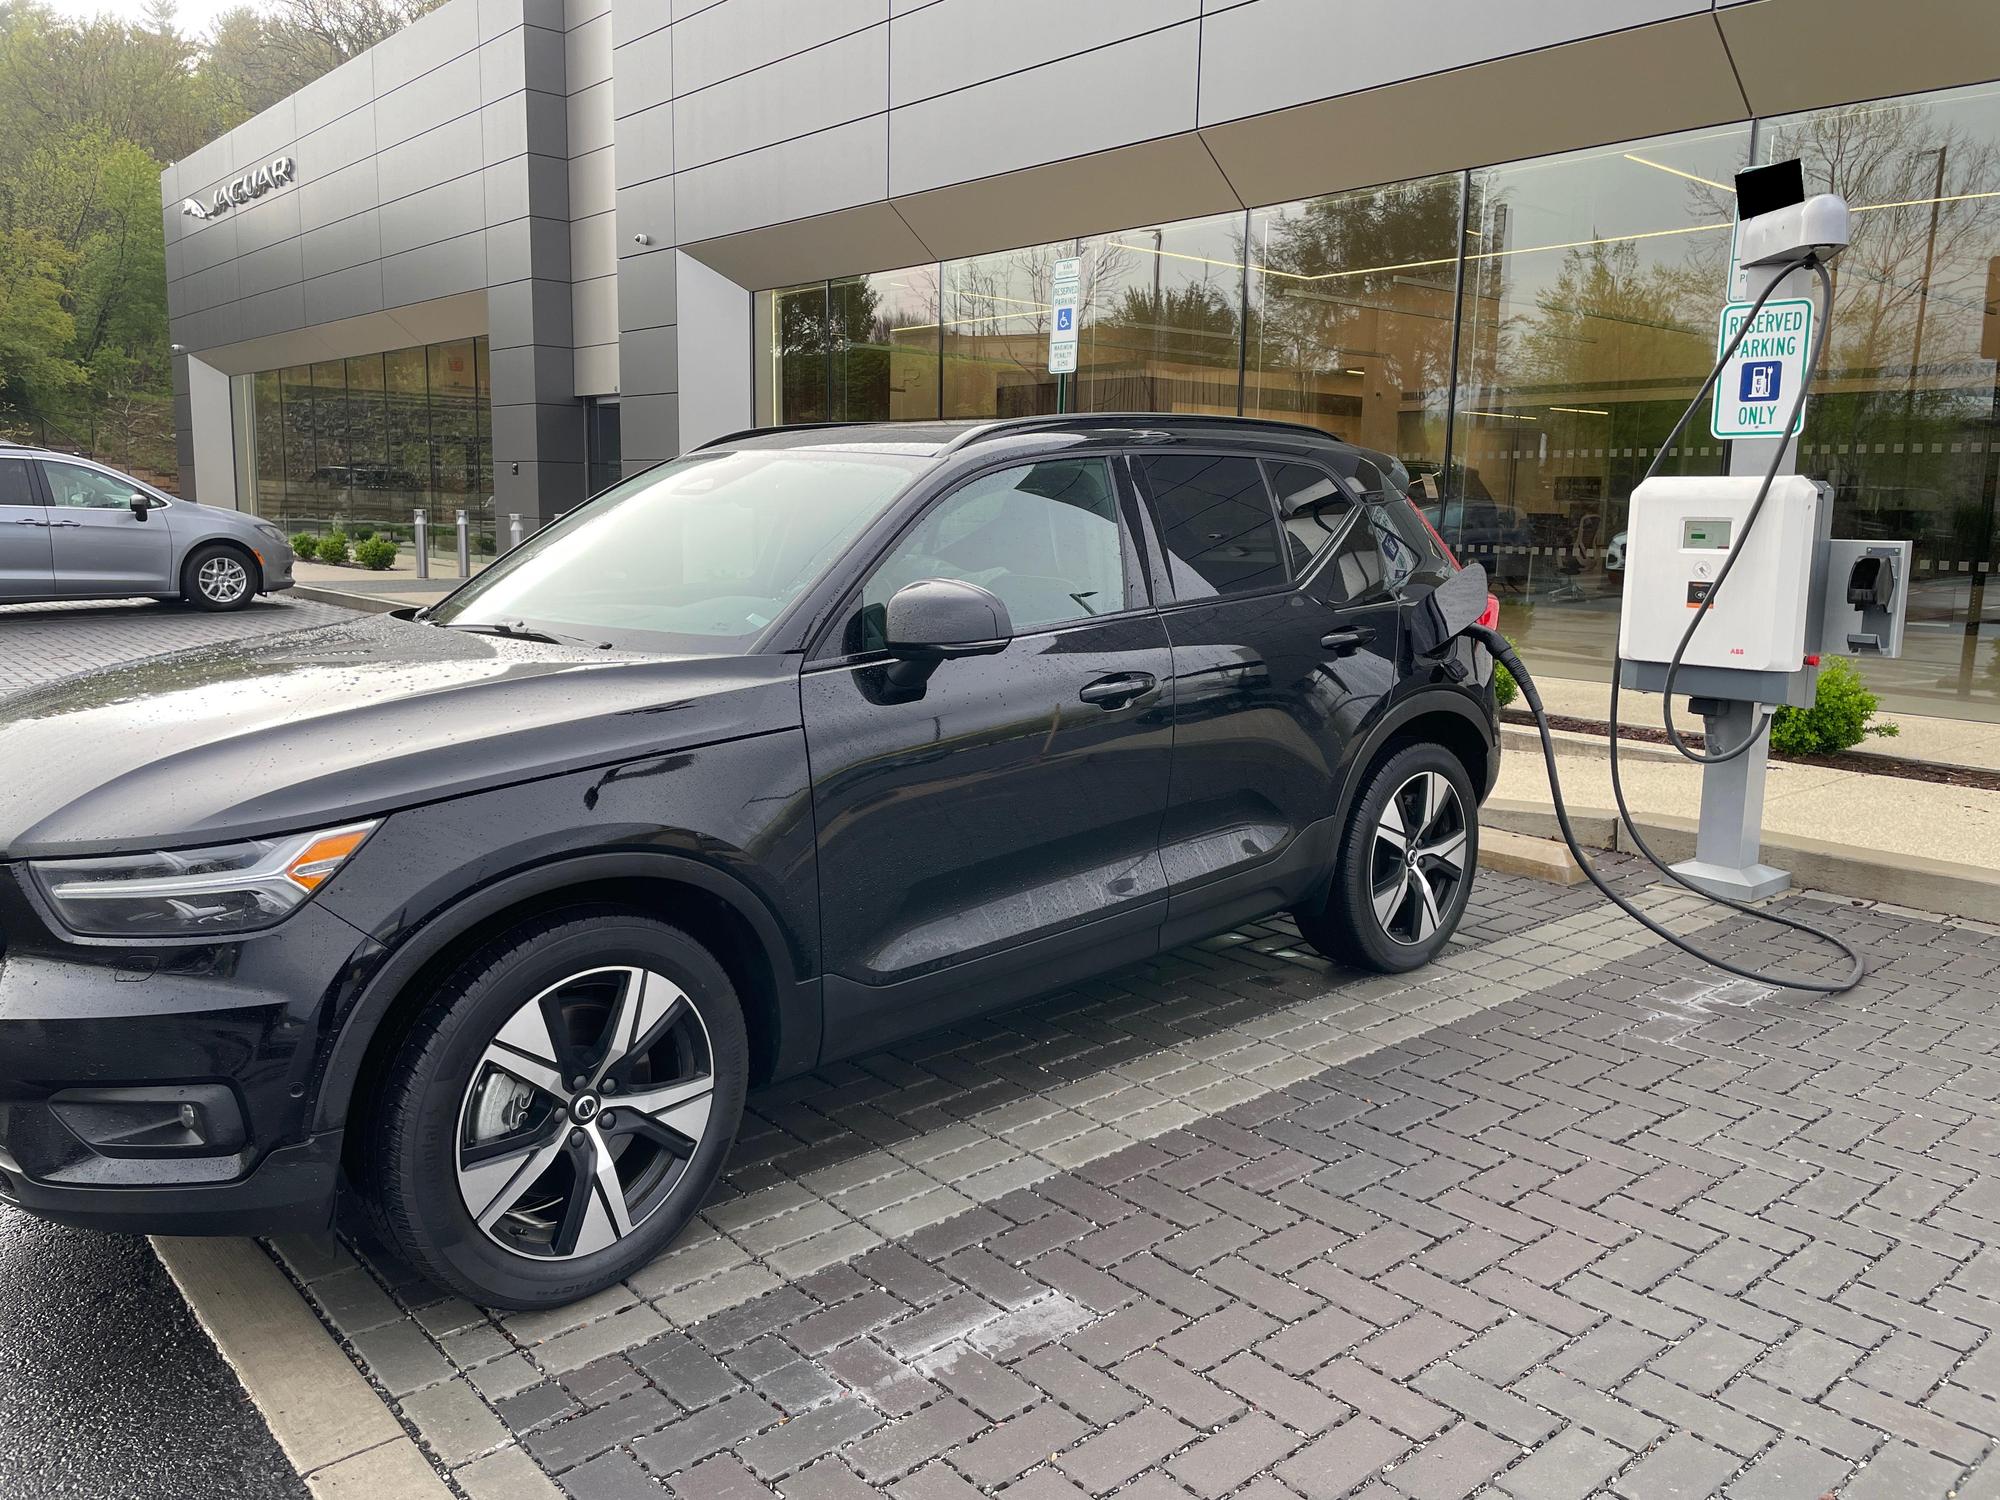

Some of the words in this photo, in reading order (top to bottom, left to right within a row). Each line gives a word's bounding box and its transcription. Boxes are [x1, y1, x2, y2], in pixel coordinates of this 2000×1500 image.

[210, 156, 294, 215] JAGUAR
[1055, 296, 1076, 305] PARKING
[1738, 405, 1777, 425] ONLY
